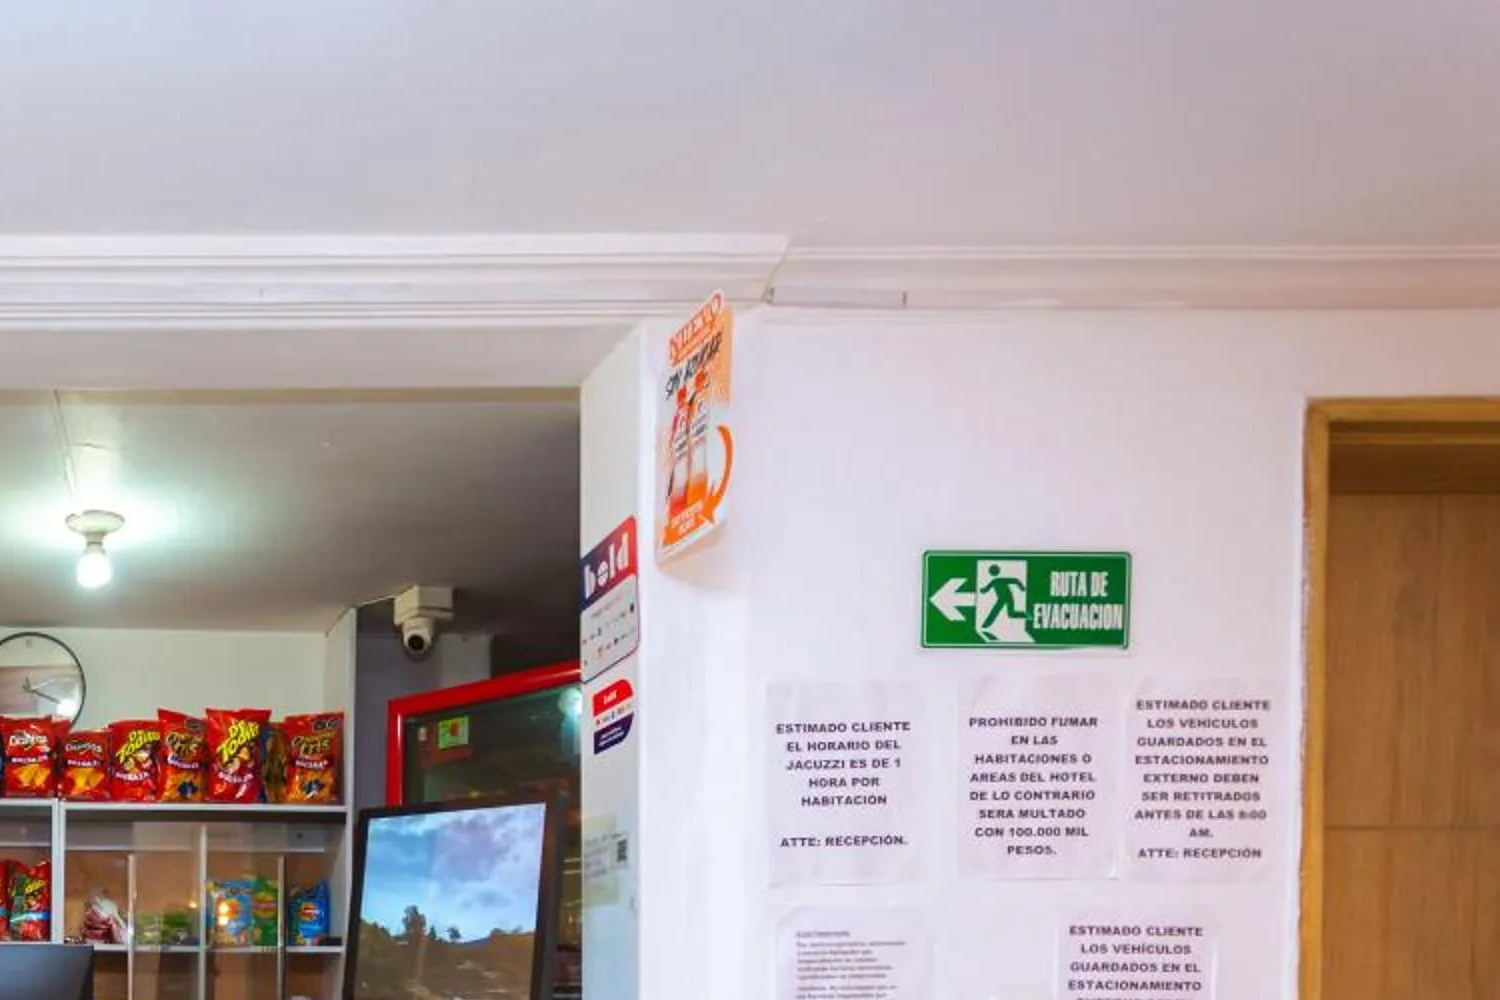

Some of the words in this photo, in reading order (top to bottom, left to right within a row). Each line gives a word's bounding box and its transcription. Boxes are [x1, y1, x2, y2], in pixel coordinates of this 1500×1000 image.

[584, 532, 628, 599] bold
[1051, 571, 1087, 596] RUTA
[1091, 572, 1108, 596] DE
[1033, 604, 1124, 629] EVACUACION
[1136, 700, 1208, 710] ESTIMADO
[1212, 700, 1270, 710] CLIENTE
[969, 718, 1047, 726] PROHIBIDO
[1051, 718, 1098, 726] FUMAR
[1147, 719, 1174, 728] LOS
[776, 723, 847, 734] ESTIMADO
[852, 722, 911, 732] CLIENTE
[1011, 736, 1028, 745] EN
[1034, 736, 1058, 745] LAS
[1137, 737, 1223, 747] GUARDADOS
[1228, 738, 1246, 746] EN
[1251, 738, 1267, 746] EL
[787, 742, 803, 752] EL
[808, 741, 870, 751] HORARIO
[875, 740, 901, 750] DEL
[975, 754, 1077, 764] HABITACIONES
[1082, 754, 1092, 763] O
[1135, 756, 1269, 765] ESTACIONAMIENTO
[786, 760, 845, 770] JACUZZI
[850, 759, 867, 768] ES
[872, 759, 889, 768] DE
[894, 759, 901, 767] 1
[809, 778, 847, 787] HORA
[852, 777, 880, 787] POR
[970, 772, 1016, 782] AREAS
[1021, 772, 1045, 782] DEL
[1050, 772, 1096, 782] HOTEL
[1144, 774, 1209, 783] EXTERNO
[1214, 774, 1259, 783] DEBEN
[970, 792, 988, 800] DE
[992, 791, 1010, 800] LO
[1014, 791, 1095, 800] CONTRARIO
[1142, 792, 1169, 801] SER
[1174, 792, 1261, 801] RETITRADOS
[1018, 809, 1085, 818] MULTADO
[1135, 810, 1182, 819] ANTES
[1186, 810, 1204, 819] DE
[1208, 810, 1234, 819] LAS
[975, 828, 1004, 837] CON
[1010, 828, 1060, 837] 100.000
[1066, 828, 1089, 836] MIL
[1189, 828, 1213, 837] AM.
[781, 838, 821, 847] ATTE:
[1007, 846, 1057, 855] PESOS.
[1138, 849, 1178, 858] ATTE:
[1069, 926, 1141, 936] ESTIMADO
[1146, 927, 1203, 937] CLIENTE
[1081, 944, 1108, 954] LOS
[1070, 962, 1158, 972] GUARDADOS
[1163, 963, 1180, 972] EN
[1185, 963, 1201, 972] EL
[1068, 981, 1202, 991] ESTACIONAMIENTO
